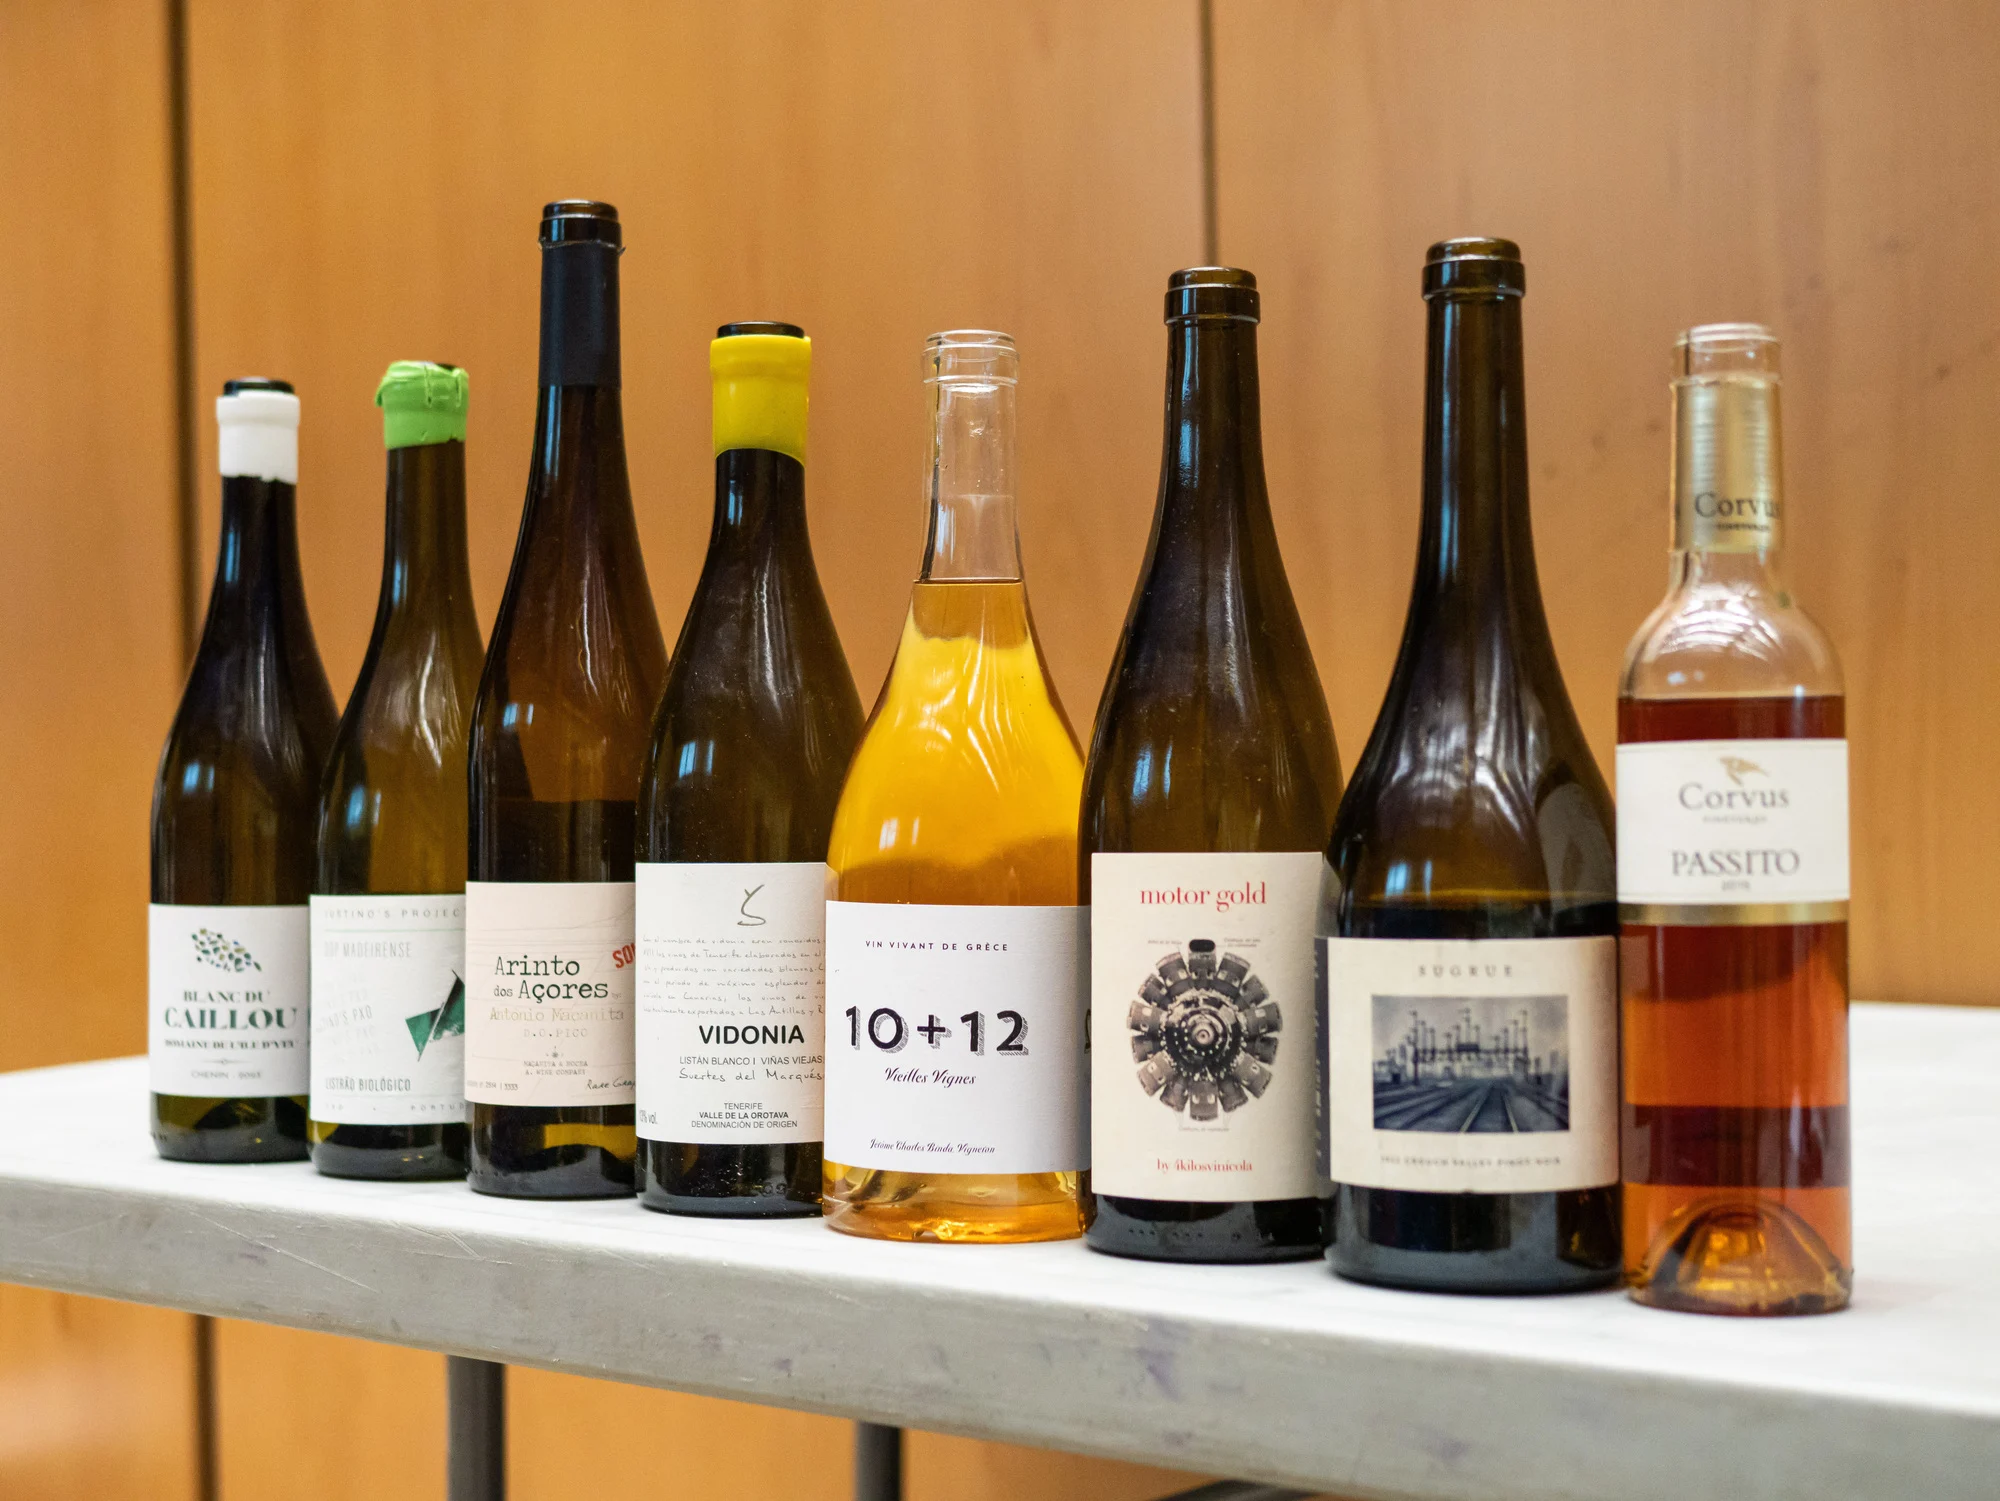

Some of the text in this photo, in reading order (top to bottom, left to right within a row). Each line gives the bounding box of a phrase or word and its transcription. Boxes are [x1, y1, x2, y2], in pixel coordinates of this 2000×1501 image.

[1677, 780, 1790, 811] Corvus
[1669, 848, 1801, 877] PASSITO
[1140, 881, 1267, 913] motor gold
[401, 906, 465, 918] PROJEC
[342, 941, 412, 958] MADEIRENSE
[702, 948, 742, 959] Tenerife
[744, 950, 797, 959] elaborados
[865, 940, 1009, 952] VIN VIVANT DE GRÈCE
[495, 955, 580, 976] Arinto
[1417, 963, 1513, 978] SUGRUE
[183, 990, 270, 1004] BLANC DU
[493, 985, 513, 998] dos
[518, 979, 609, 1004] Açores
[164, 1006, 298, 1030] CAILLOU
[687, 1007, 736, 1018] exportados
[748, 1006, 766, 1016] Las
[769, 1004, 806, 1016] Antillas
[699, 1025, 805, 1045] VIDONIA
[679, 1055, 709, 1066] LISTÁN
[711, 1056, 751, 1066] BLANCO
[760, 1055, 790, 1066] VIÑAS
[792, 1055, 823, 1066] VIEJAS
[324, 1076, 411, 1092] LISTRÃO BIOLÓGICO
[678, 1067, 823, 1084] Suertes del Marqués
[884, 1066, 977, 1089] Vieilles Vignes
[723, 1102, 763, 1111] TENERIFE
[691, 1119, 798, 1129] DENOMINACIÓN DE ORIGEN
[699, 1111, 789, 1120] VALLE DE LA OROTAVA
[895, 1139, 926, 1152] Charles
[957, 1142, 996, 1156] Vigneron
[1157, 1157, 1169, 1175] by
